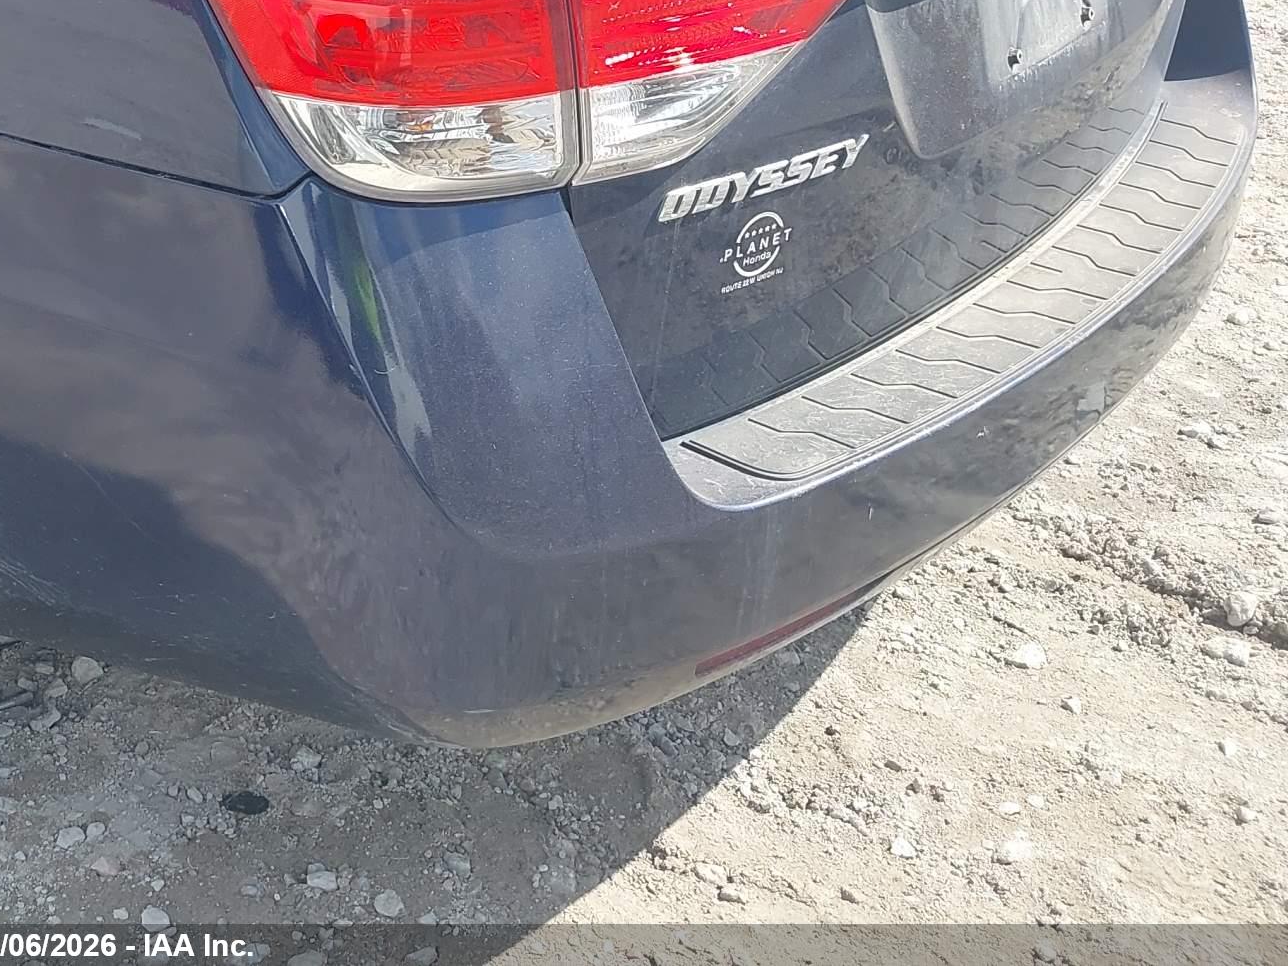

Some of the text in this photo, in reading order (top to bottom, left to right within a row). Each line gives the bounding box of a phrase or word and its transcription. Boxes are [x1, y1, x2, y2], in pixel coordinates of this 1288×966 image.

[658, 133, 870, 222] ODYSSEY
[723, 228, 792, 262] PLANET
[743, 251, 772, 267] Honda
[721, 281, 743, 294] ROUTE
